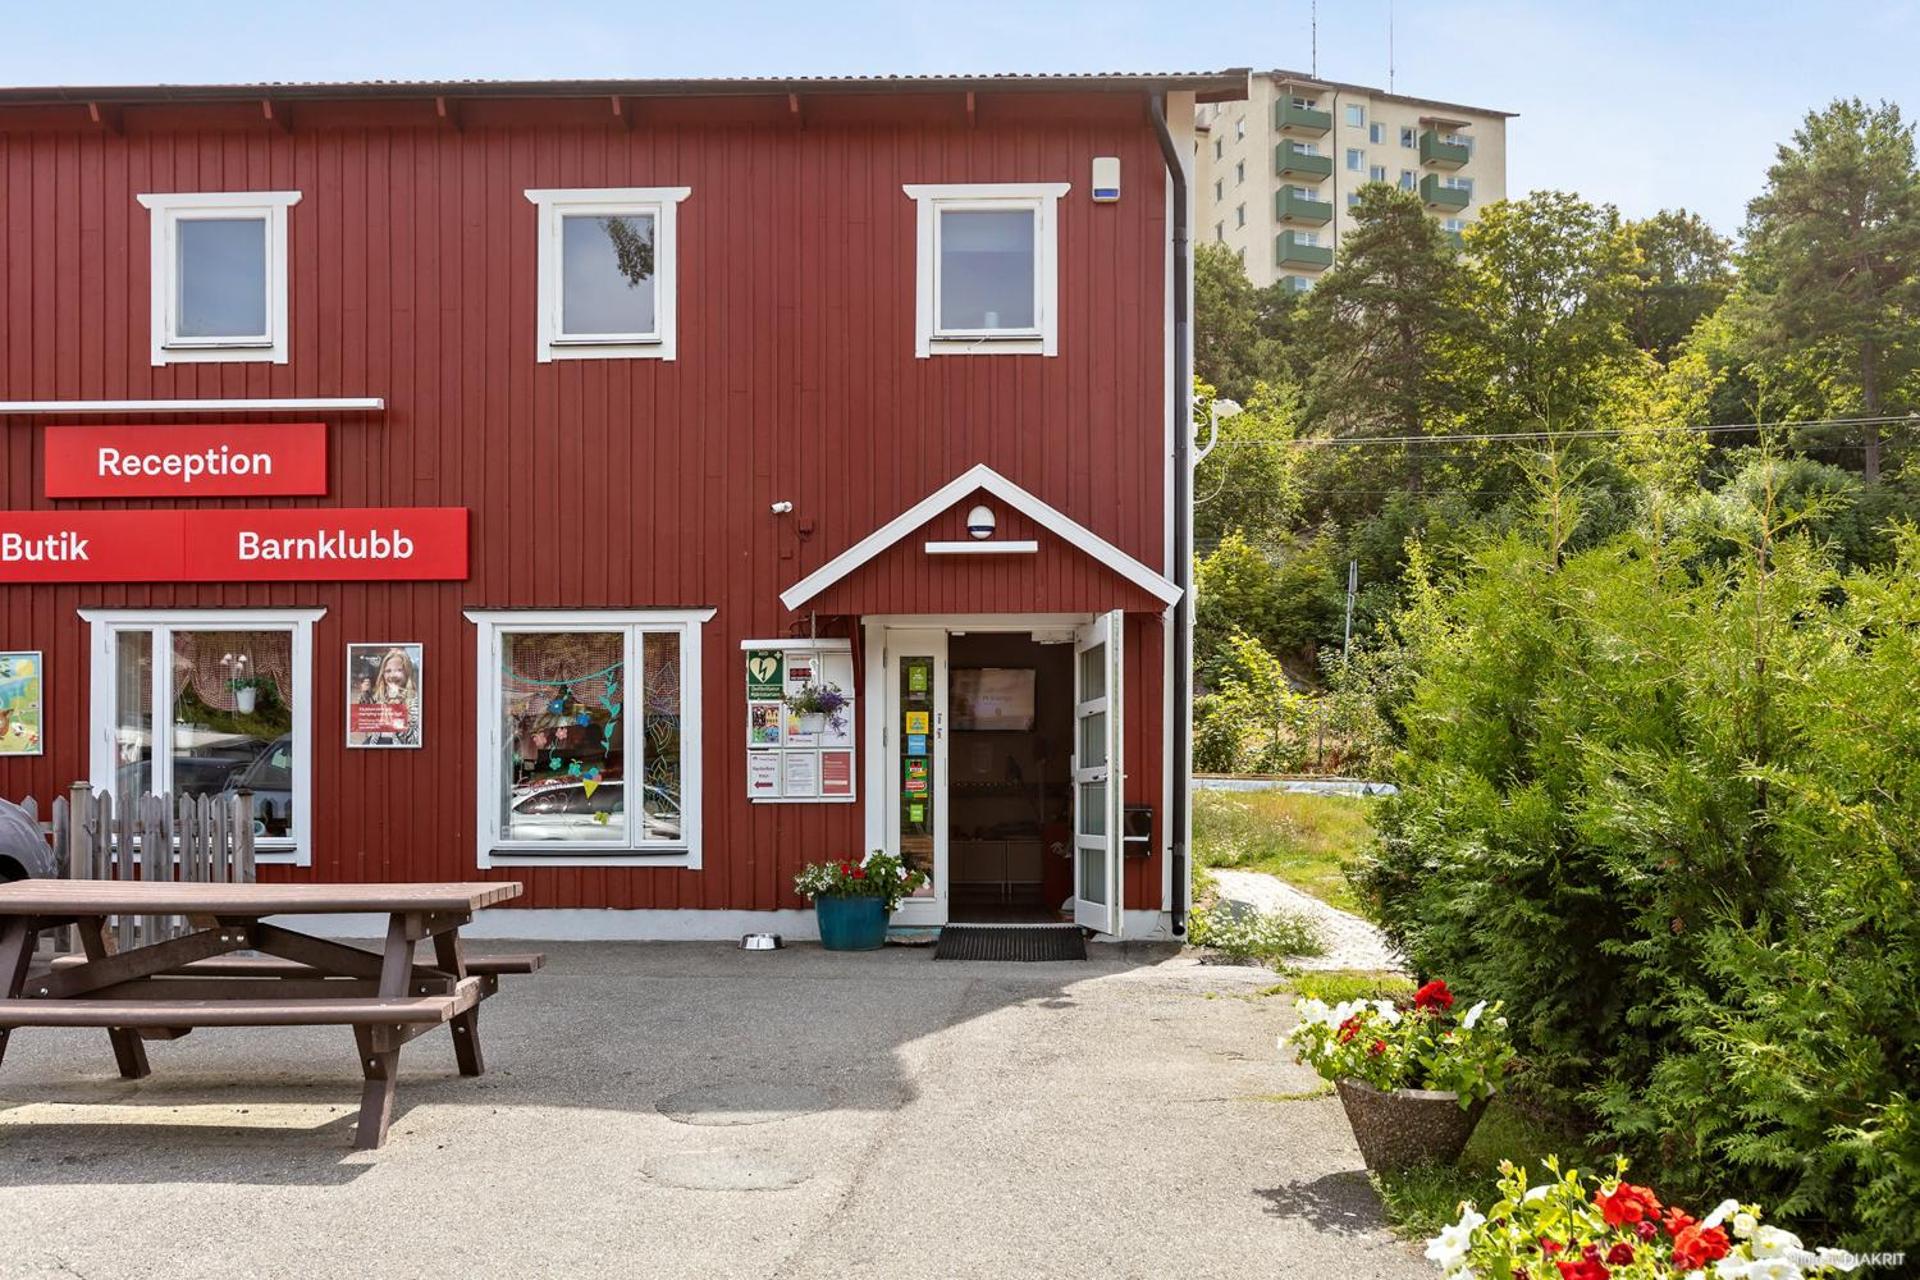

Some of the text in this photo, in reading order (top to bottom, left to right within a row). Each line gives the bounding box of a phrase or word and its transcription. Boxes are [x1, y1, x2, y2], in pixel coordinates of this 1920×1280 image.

[97, 445, 272, 483] Reception
[1, 530, 90, 562] Butik
[237, 528, 415, 562] Barnklubb
